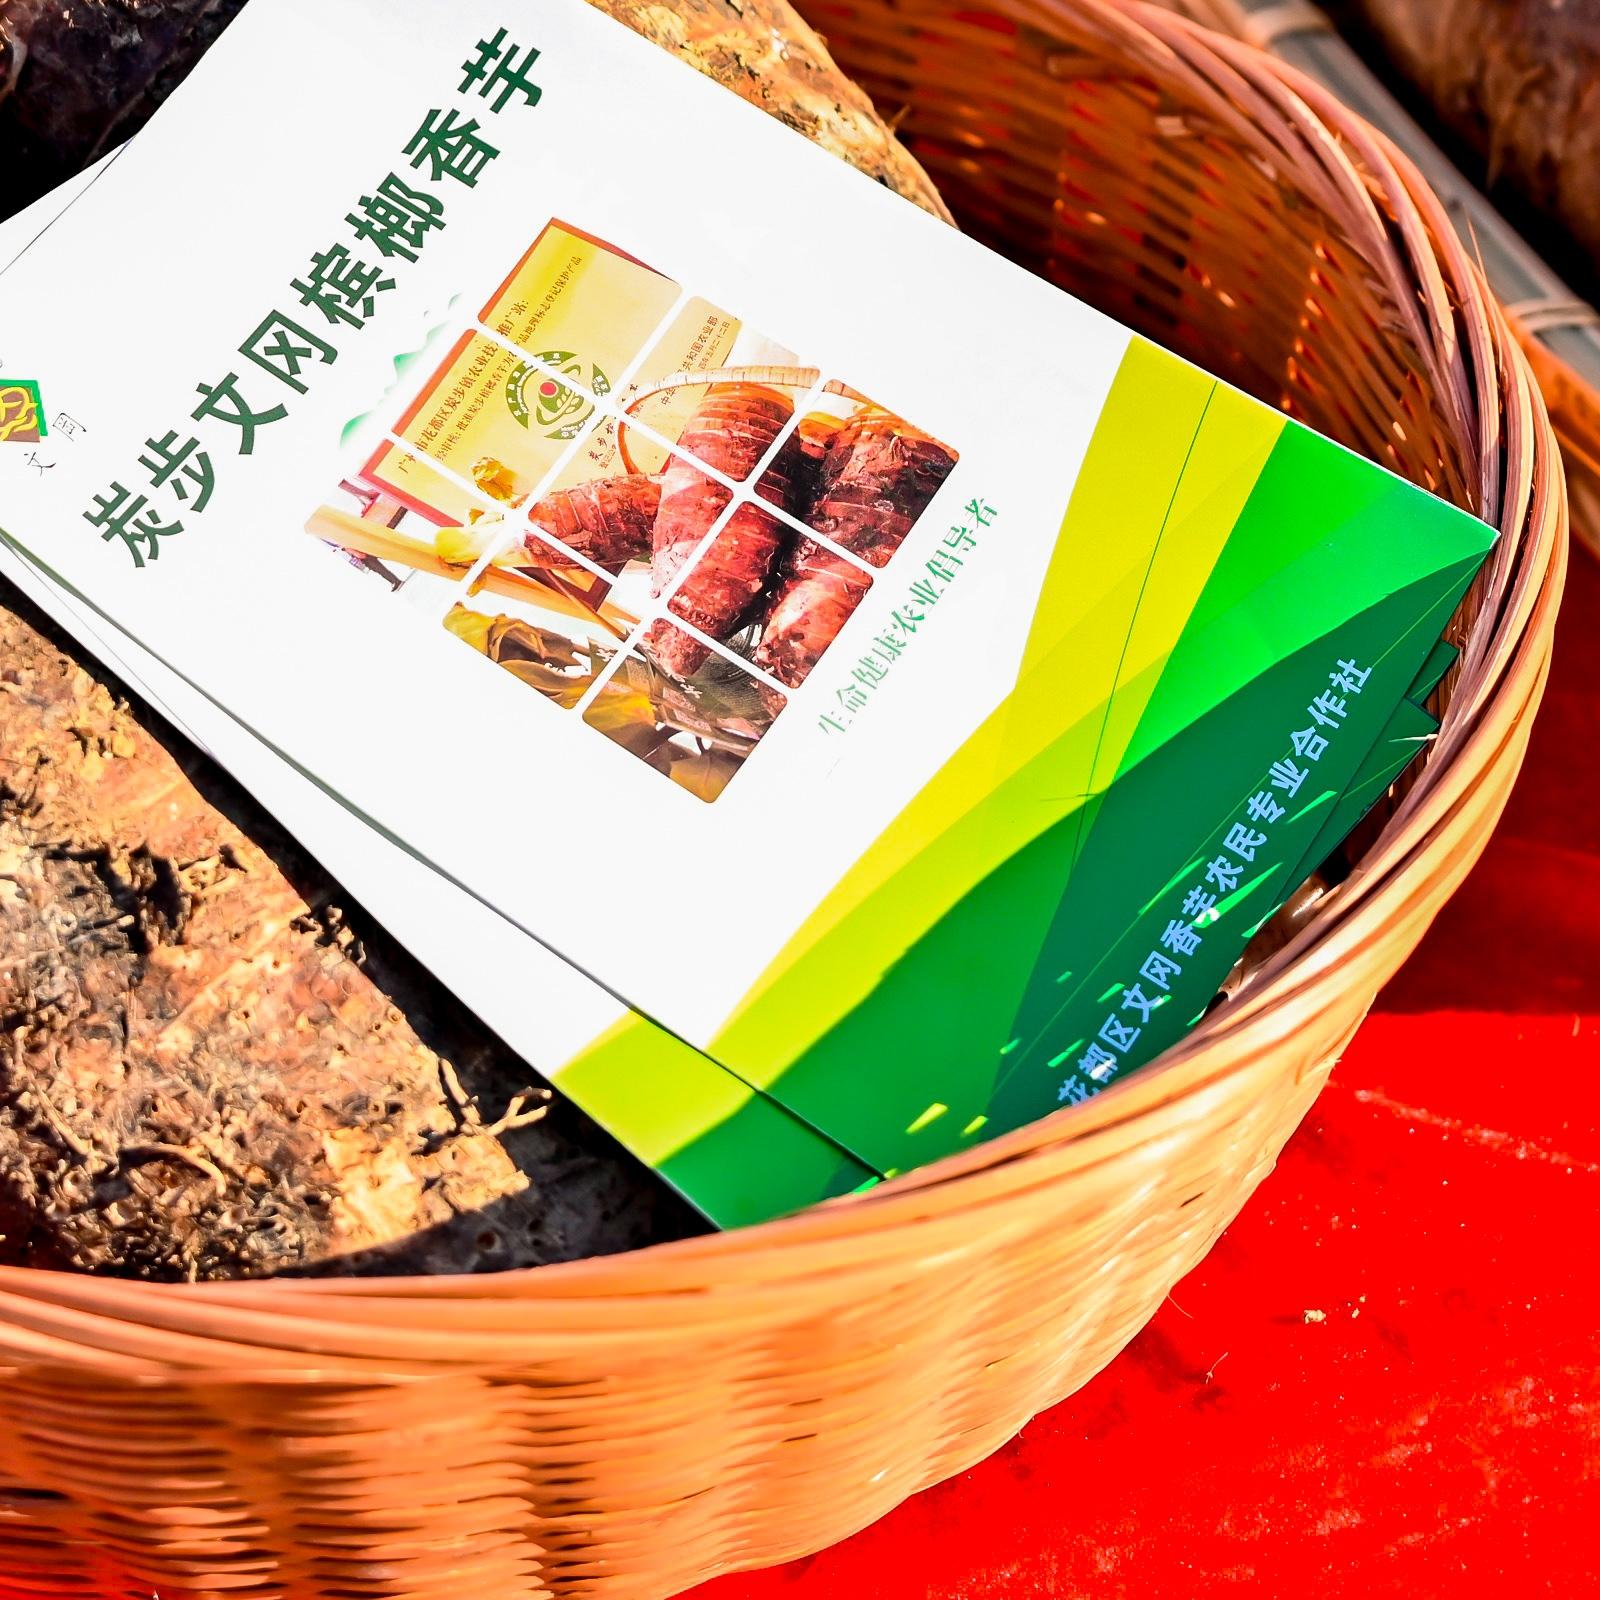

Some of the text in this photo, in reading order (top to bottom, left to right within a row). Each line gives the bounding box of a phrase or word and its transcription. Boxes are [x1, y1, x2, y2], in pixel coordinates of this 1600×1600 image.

[82, 27, 544, 570] 炭步文冈槟榔香芋
[661, 315, 719, 405] 中华共和国农业部
[818, 497, 999, 736] 生命健康农业倡导者
[1057, 658, 1374, 1107] 花都区文冈香芋农民专业合作社
